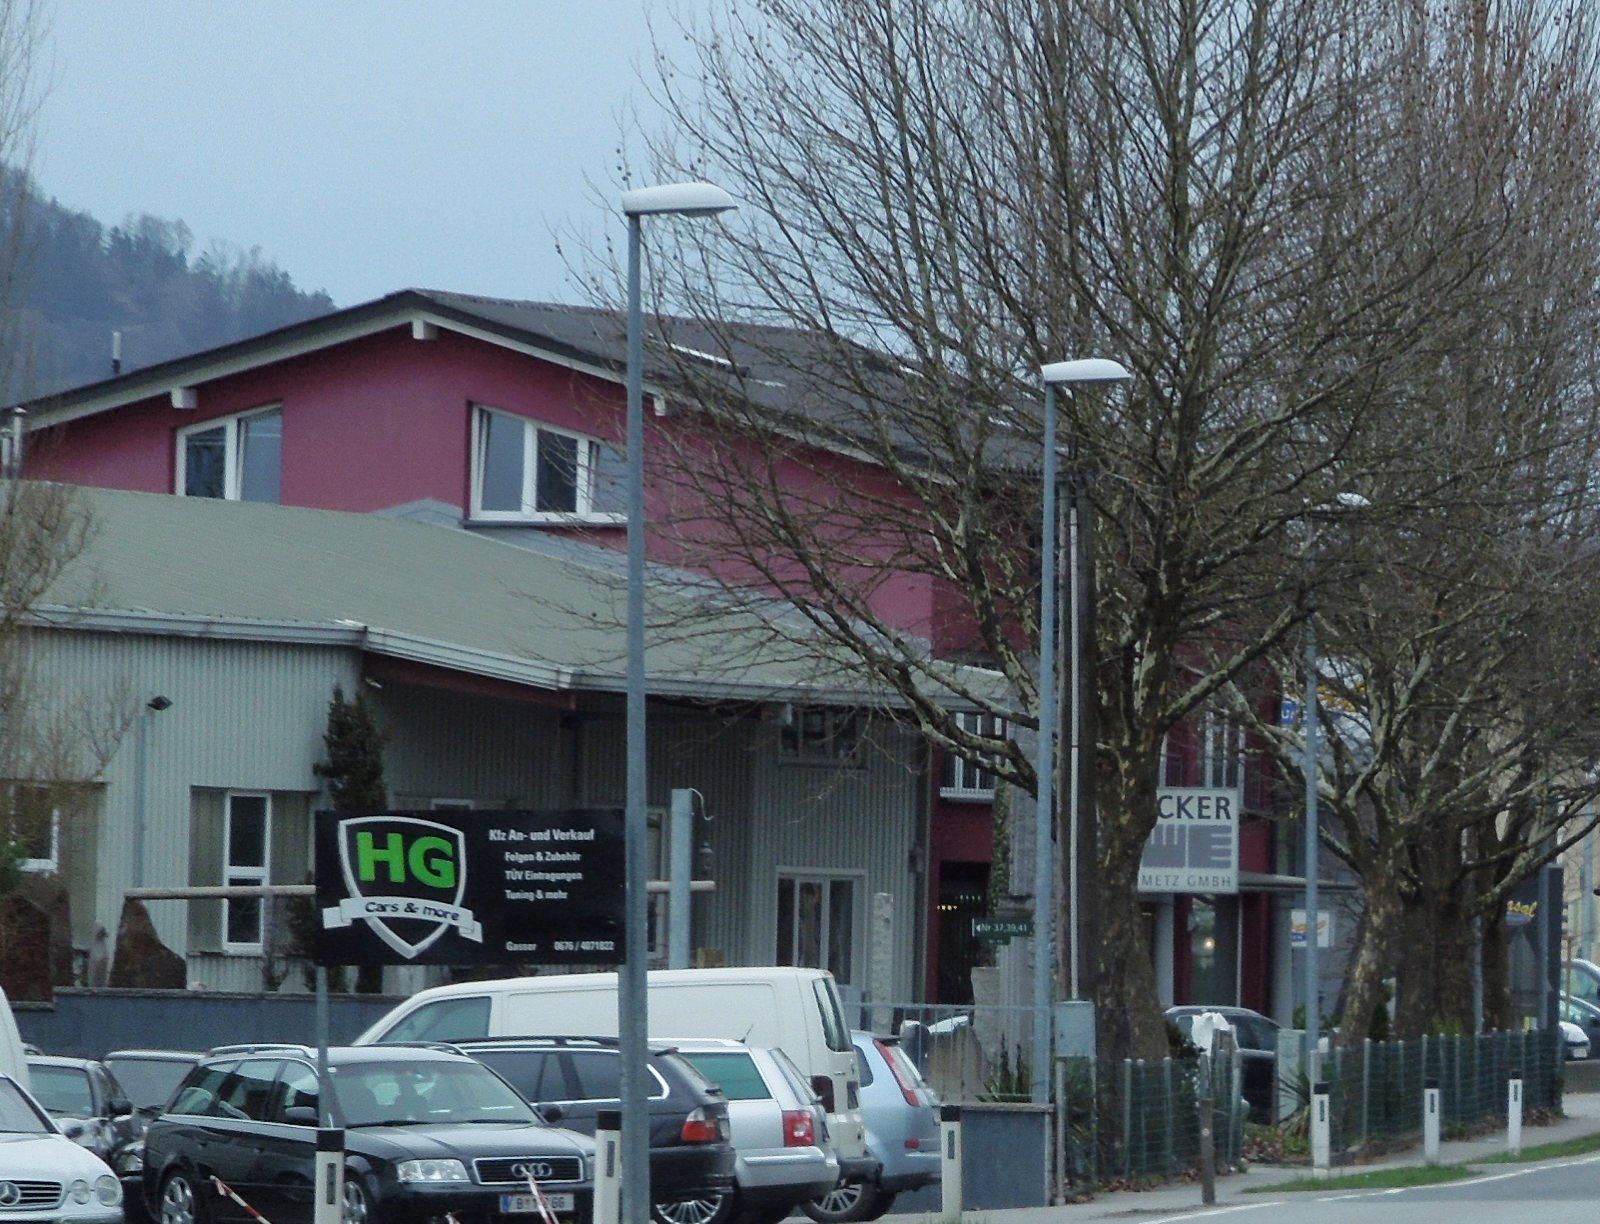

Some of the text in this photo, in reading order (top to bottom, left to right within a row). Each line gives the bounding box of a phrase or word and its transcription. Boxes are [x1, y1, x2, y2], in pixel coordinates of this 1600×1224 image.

[489, 828, 595, 841] Kfz An- und Verkauf
[356, 832, 456, 889] HG
[505, 851, 581, 863] Felgen & Zubehör
[505, 868, 583, 882] TÜV Eintragungen
[1141, 875, 1232, 888] METZ GMBH
[505, 890, 568, 901] Tuning & mehr
[364, 901, 460, 921] Cars & more
